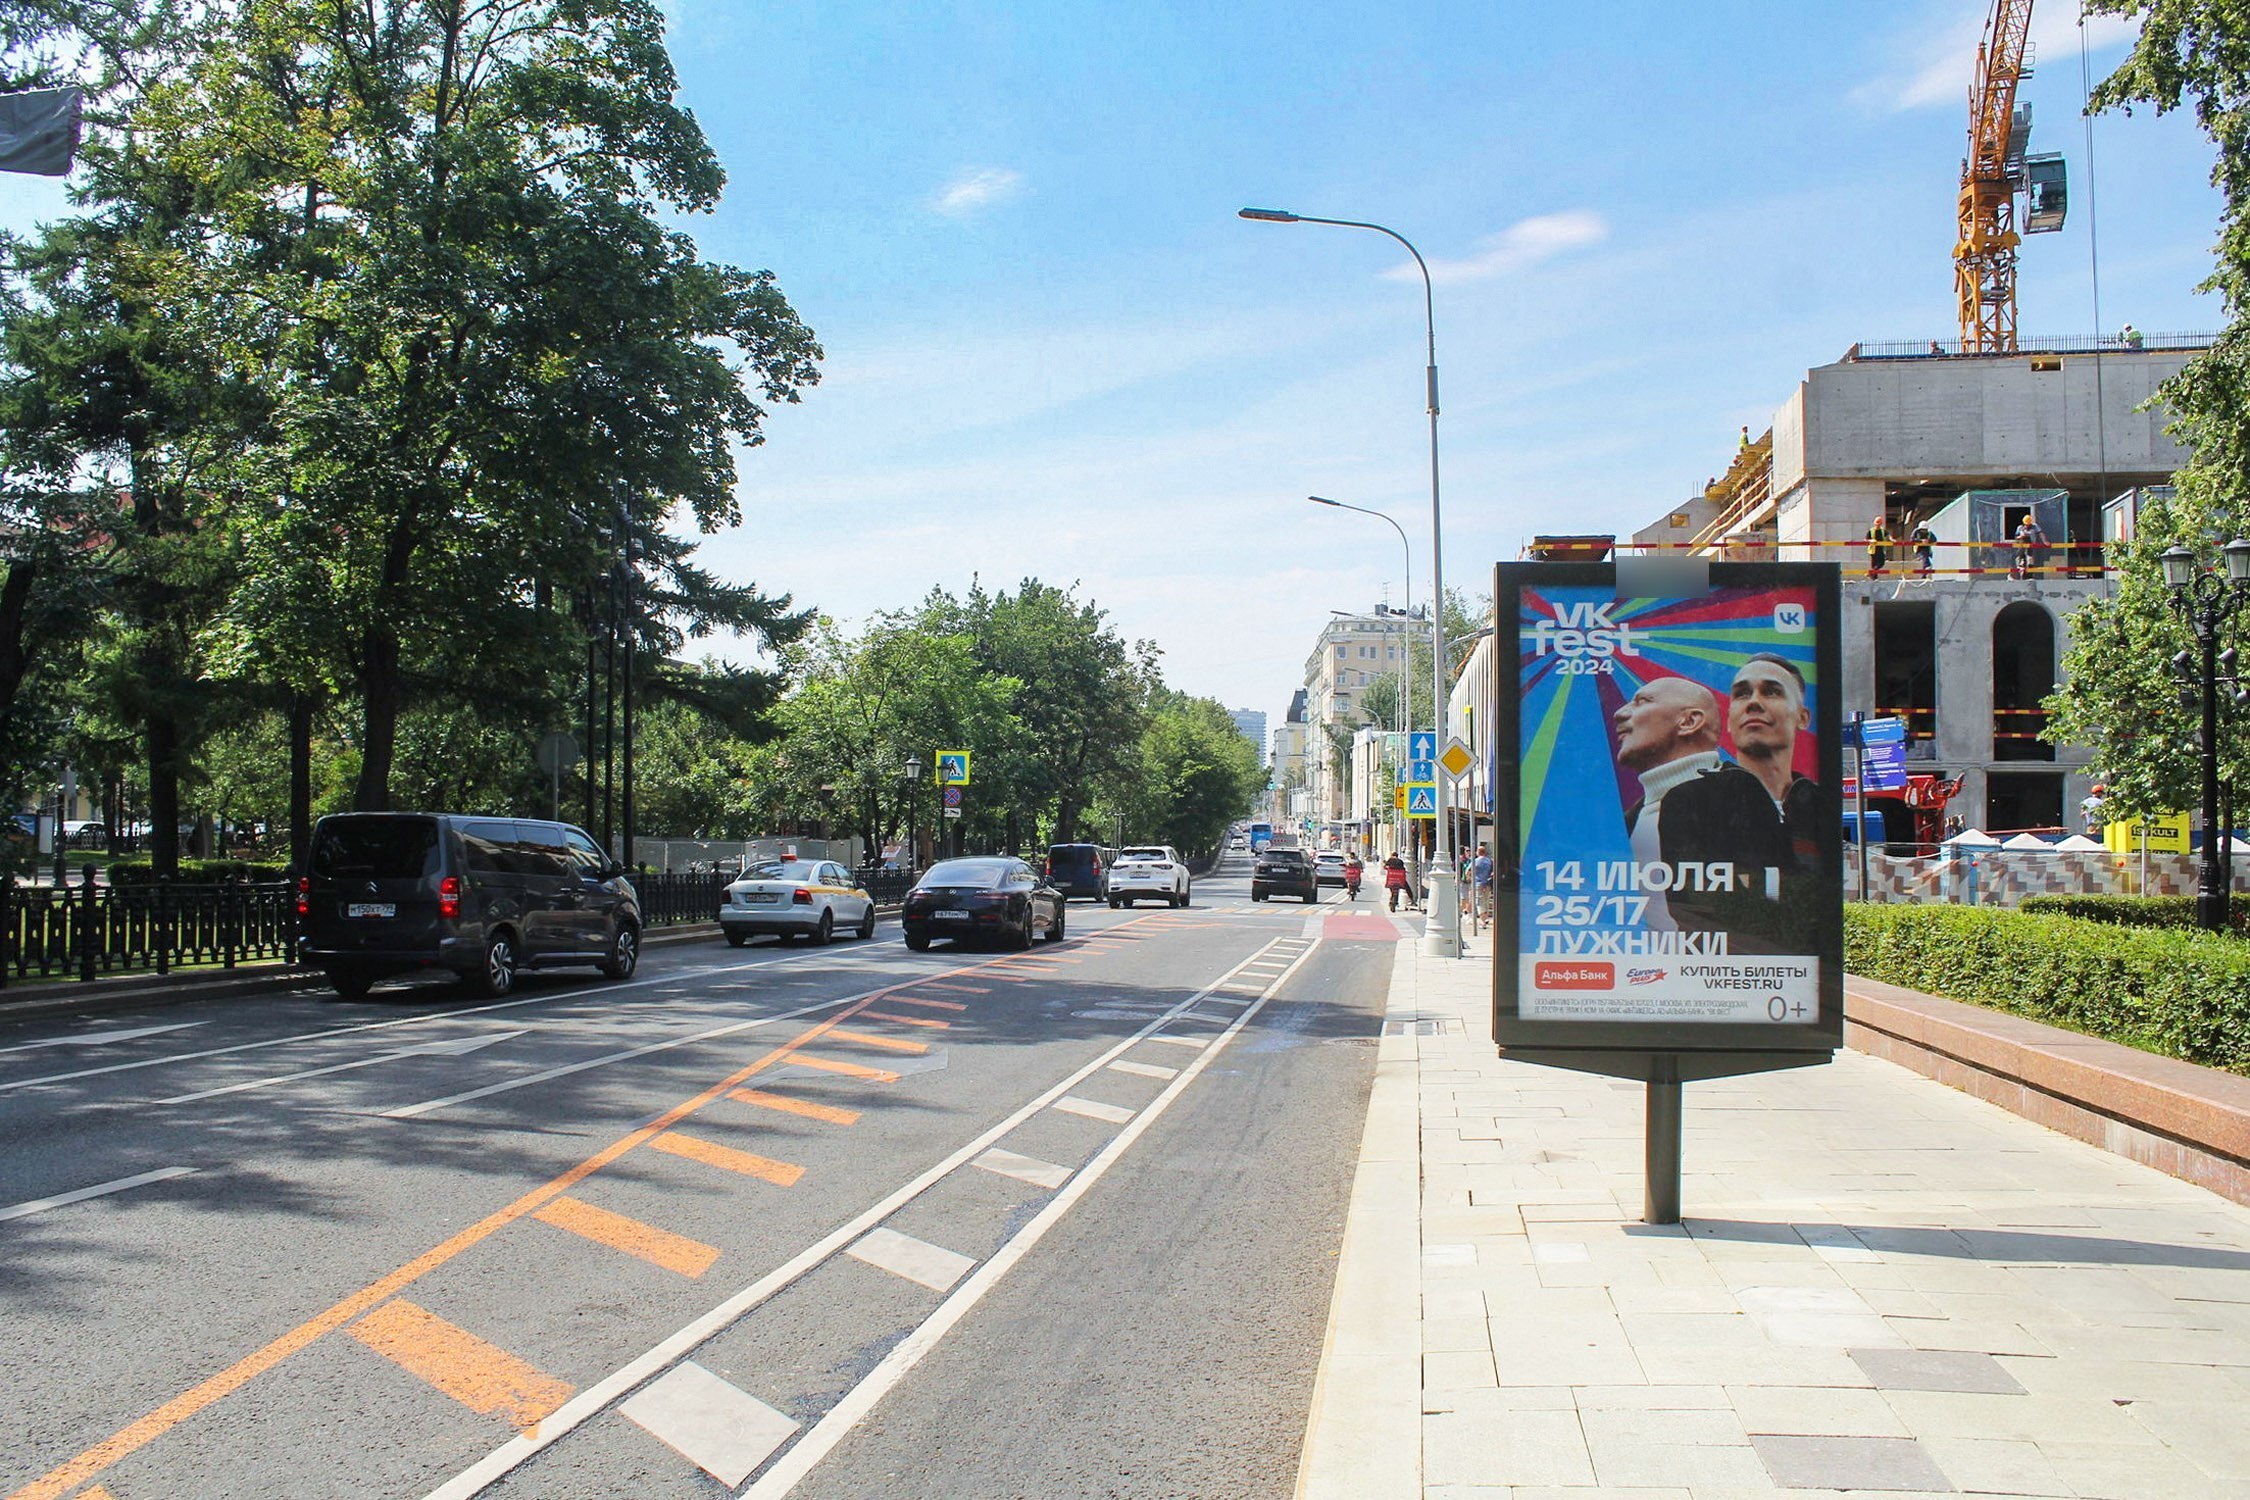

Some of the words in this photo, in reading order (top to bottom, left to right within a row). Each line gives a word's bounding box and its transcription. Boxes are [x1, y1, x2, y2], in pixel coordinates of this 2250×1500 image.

[1553, 602, 1616, 628] VK
[1779, 612, 1800, 626] VK
[1520, 619, 1650, 657] fest
[1555, 658, 1615, 675] 2024
[1536, 861, 1585, 891] 14
[1597, 861, 1734, 892] ИЮЛЯ
[1536, 896, 1650, 926] 25/17
[1536, 930, 1728, 955] ЛУЖНИКИ
[1542, 969, 1578, 983] Альфа
[1580, 969, 1608, 981] Банк
[1680, 965, 1740, 978] КУПИТЬ
[1744, 966, 1807, 978] БИЛЕТЫ
[1704, 979, 1784, 990] VKFEST.RU
[1767, 996, 1808, 1022] 0+
